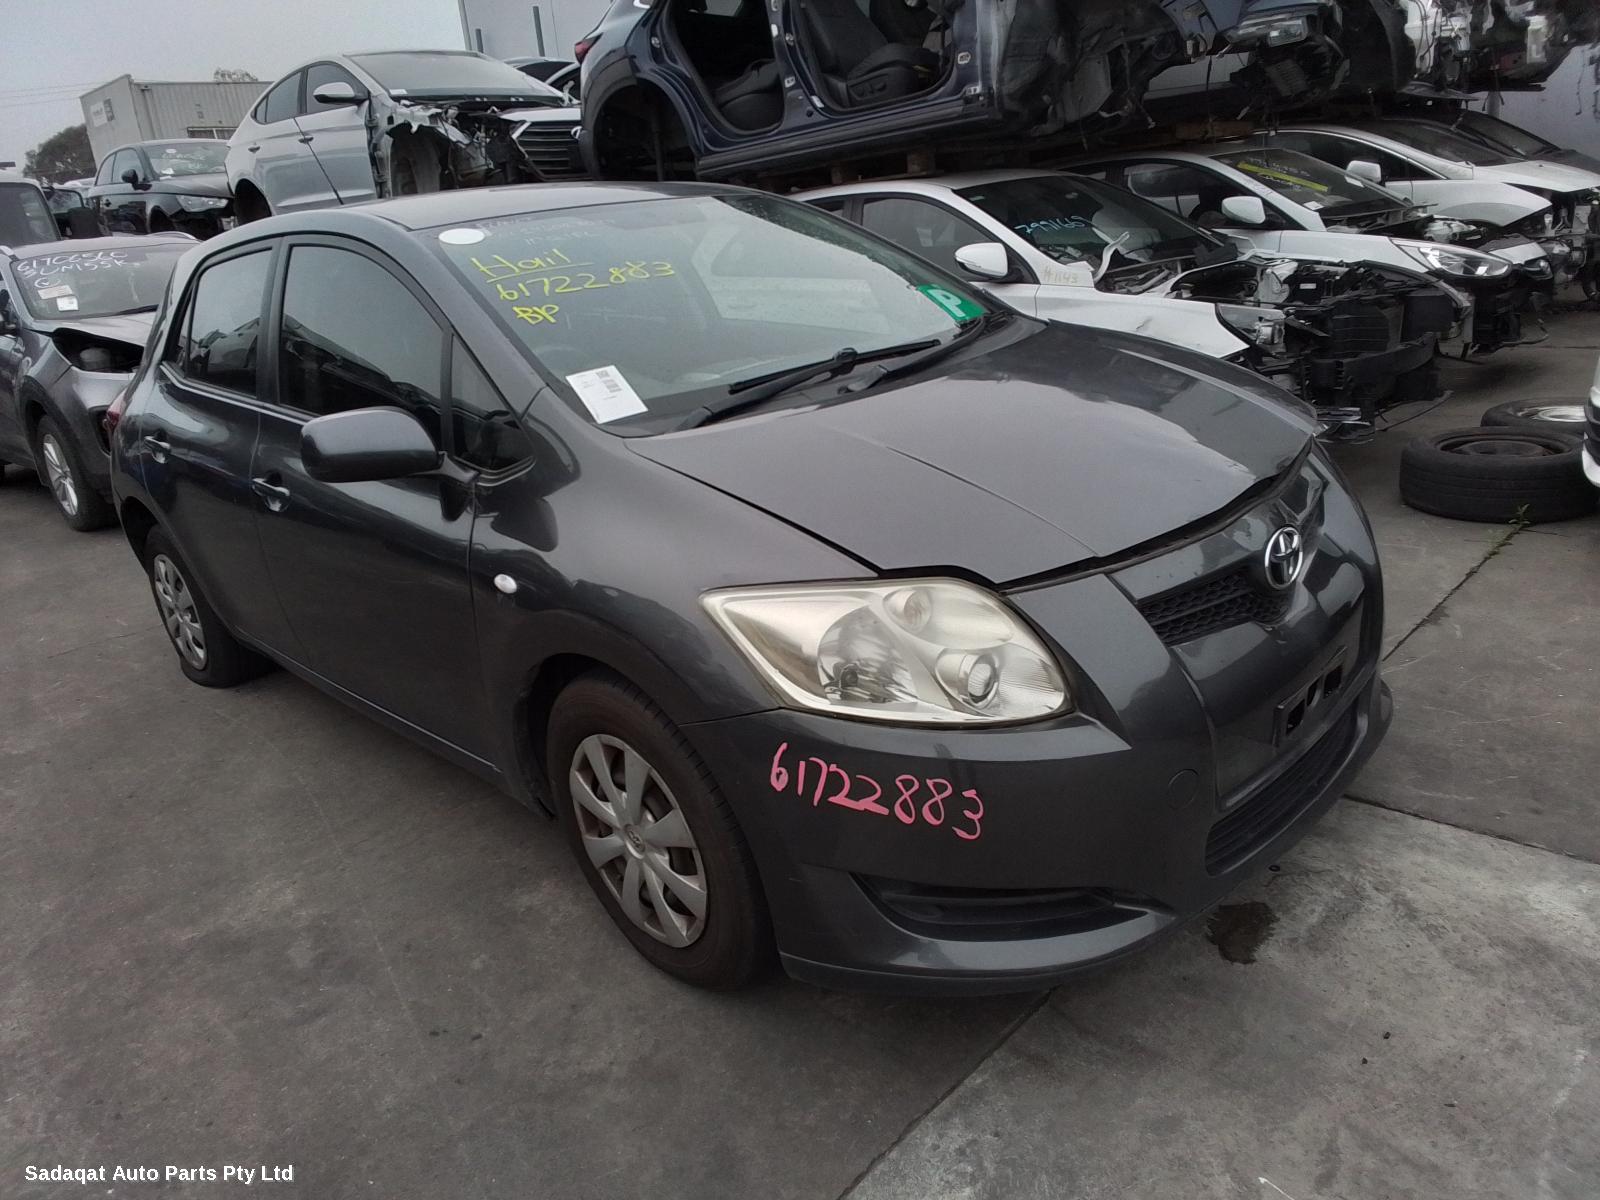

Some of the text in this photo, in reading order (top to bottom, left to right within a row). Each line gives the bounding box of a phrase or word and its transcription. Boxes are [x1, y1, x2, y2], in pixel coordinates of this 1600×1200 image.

[471, 249, 571, 278] Hail
[496, 261, 675, 300] 61722883
[770, 742, 984, 840] 61722883
